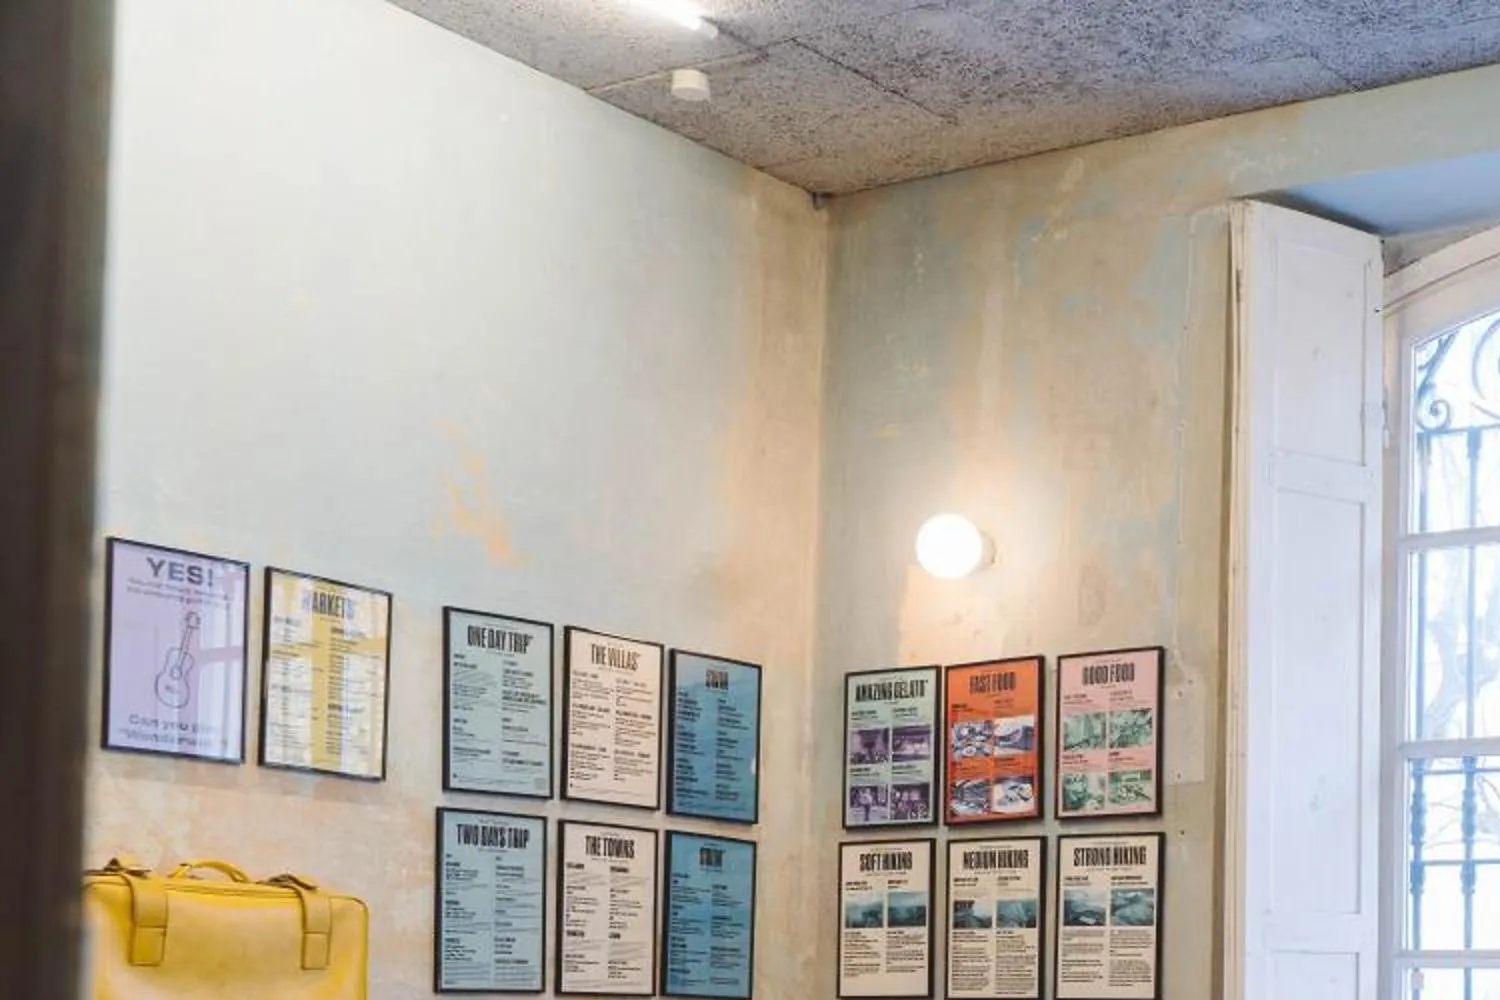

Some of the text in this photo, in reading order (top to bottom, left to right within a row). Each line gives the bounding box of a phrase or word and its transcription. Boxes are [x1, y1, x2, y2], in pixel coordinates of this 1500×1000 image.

[146, 556, 213, 588] YES!
[467, 625, 487, 649] ONE
[488, 628, 506, 651] DAY
[590, 643, 606, 665] THE
[1110, 662, 1135, 682] FOOD
[456, 823, 529, 849] TWO DAYS TRIP
[585, 835, 602, 857] THE
[859, 853, 881, 872] SOFT
[1073, 845, 1147, 867] STRONG HIKING
